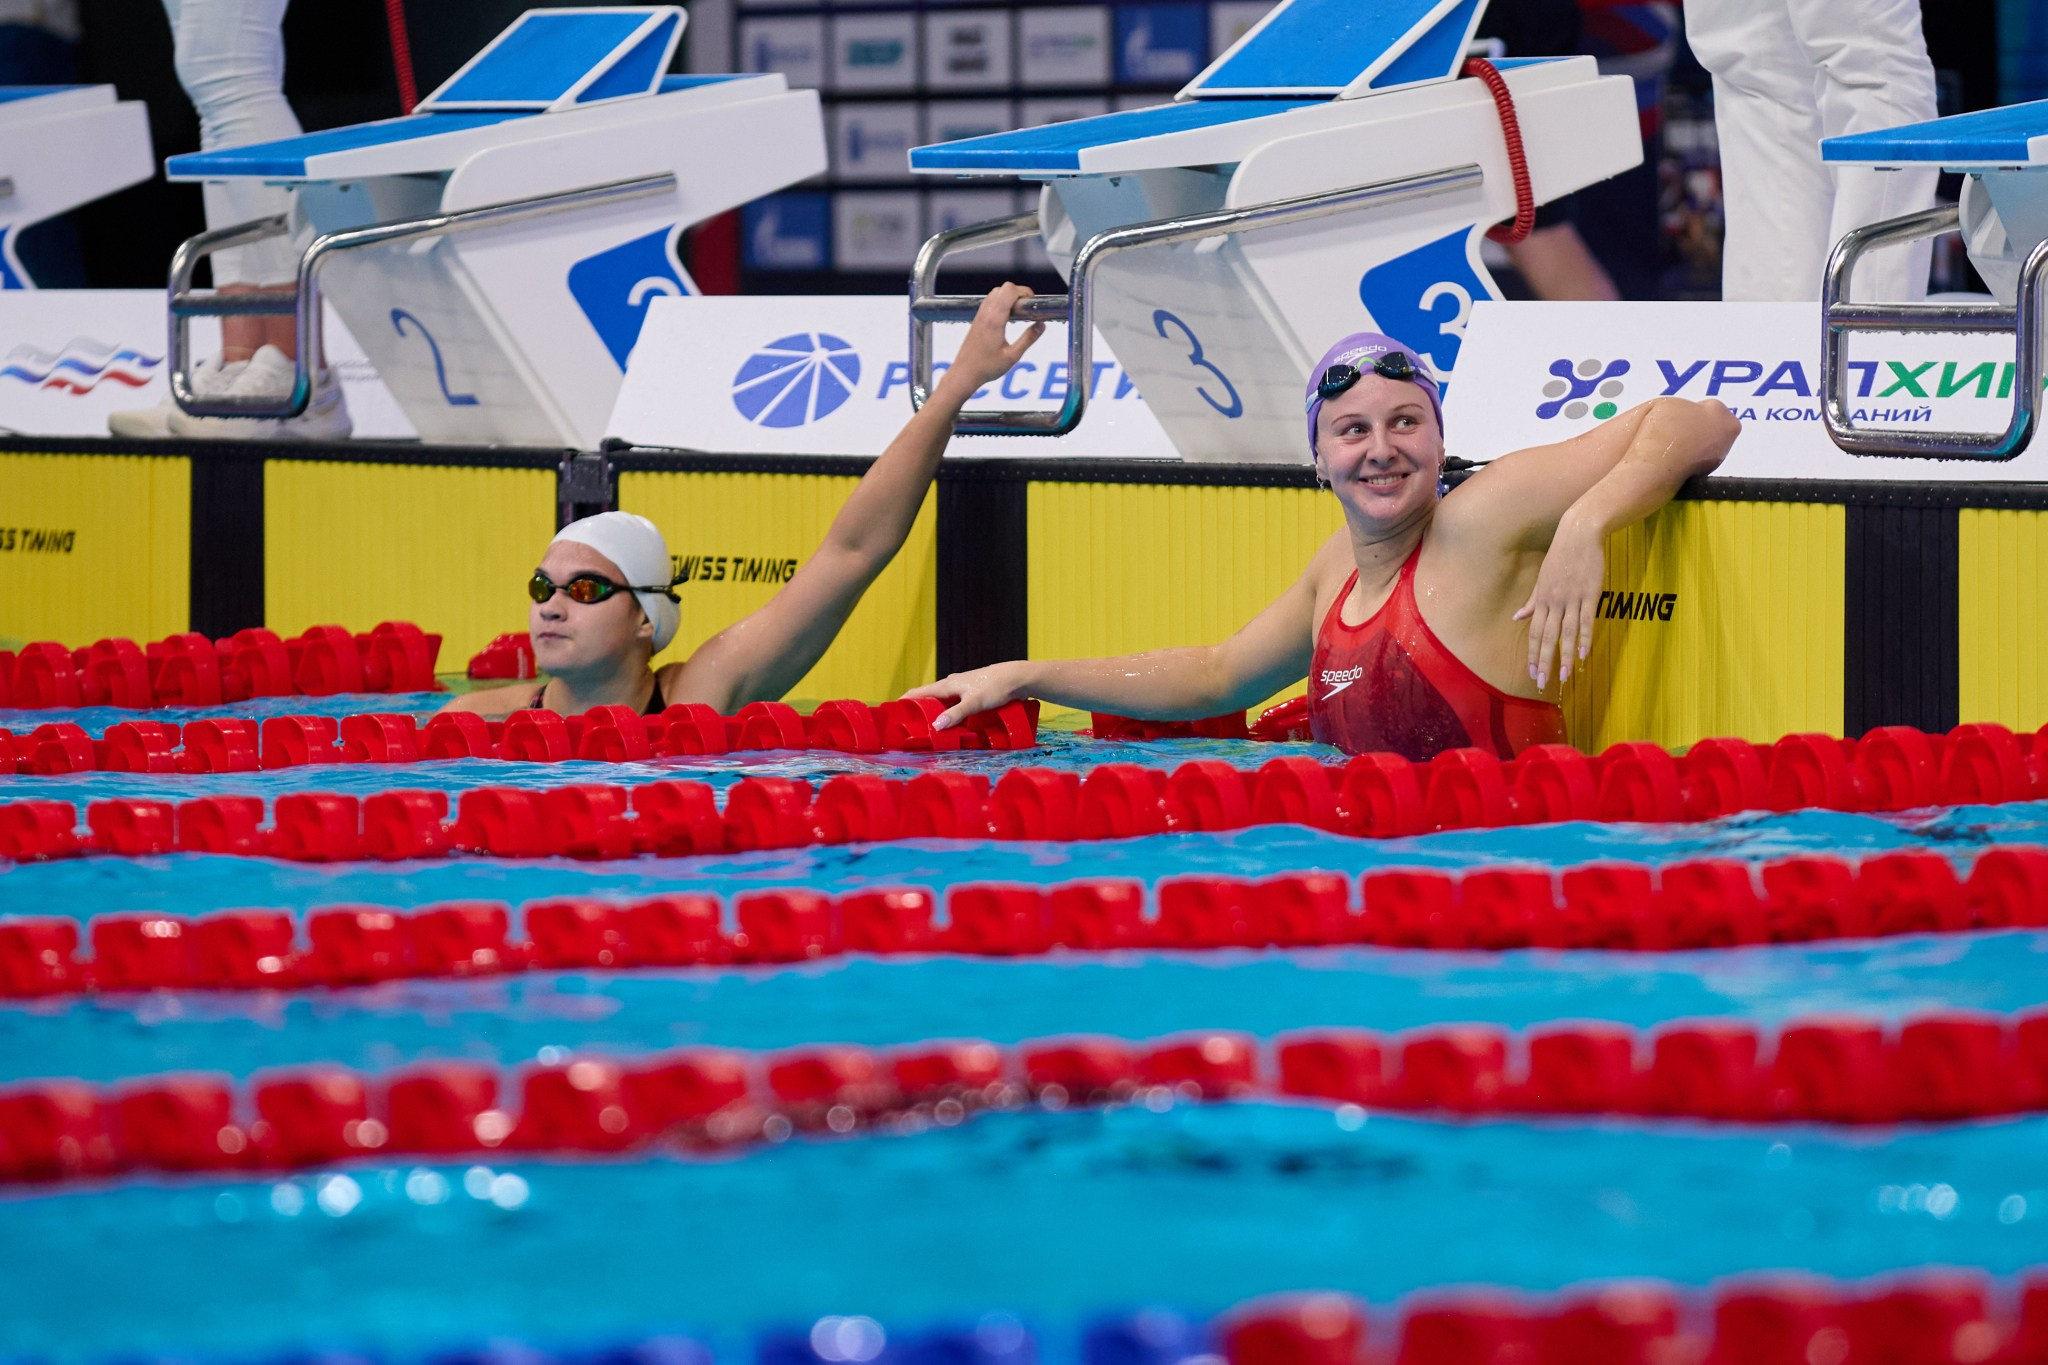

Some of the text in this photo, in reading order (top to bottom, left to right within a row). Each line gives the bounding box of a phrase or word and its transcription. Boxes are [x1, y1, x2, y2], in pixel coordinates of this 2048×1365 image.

[1418, 281, 1472, 383] 3
[390, 307, 480, 407] 2
[1153, 309, 1243, 418] 3
[1333, 344, 1387, 365] speedo
[731, 556, 798, 584] TIMING
[1595, 590, 1678, 622] TIMING
[1320, 664, 1363, 685] speedo
